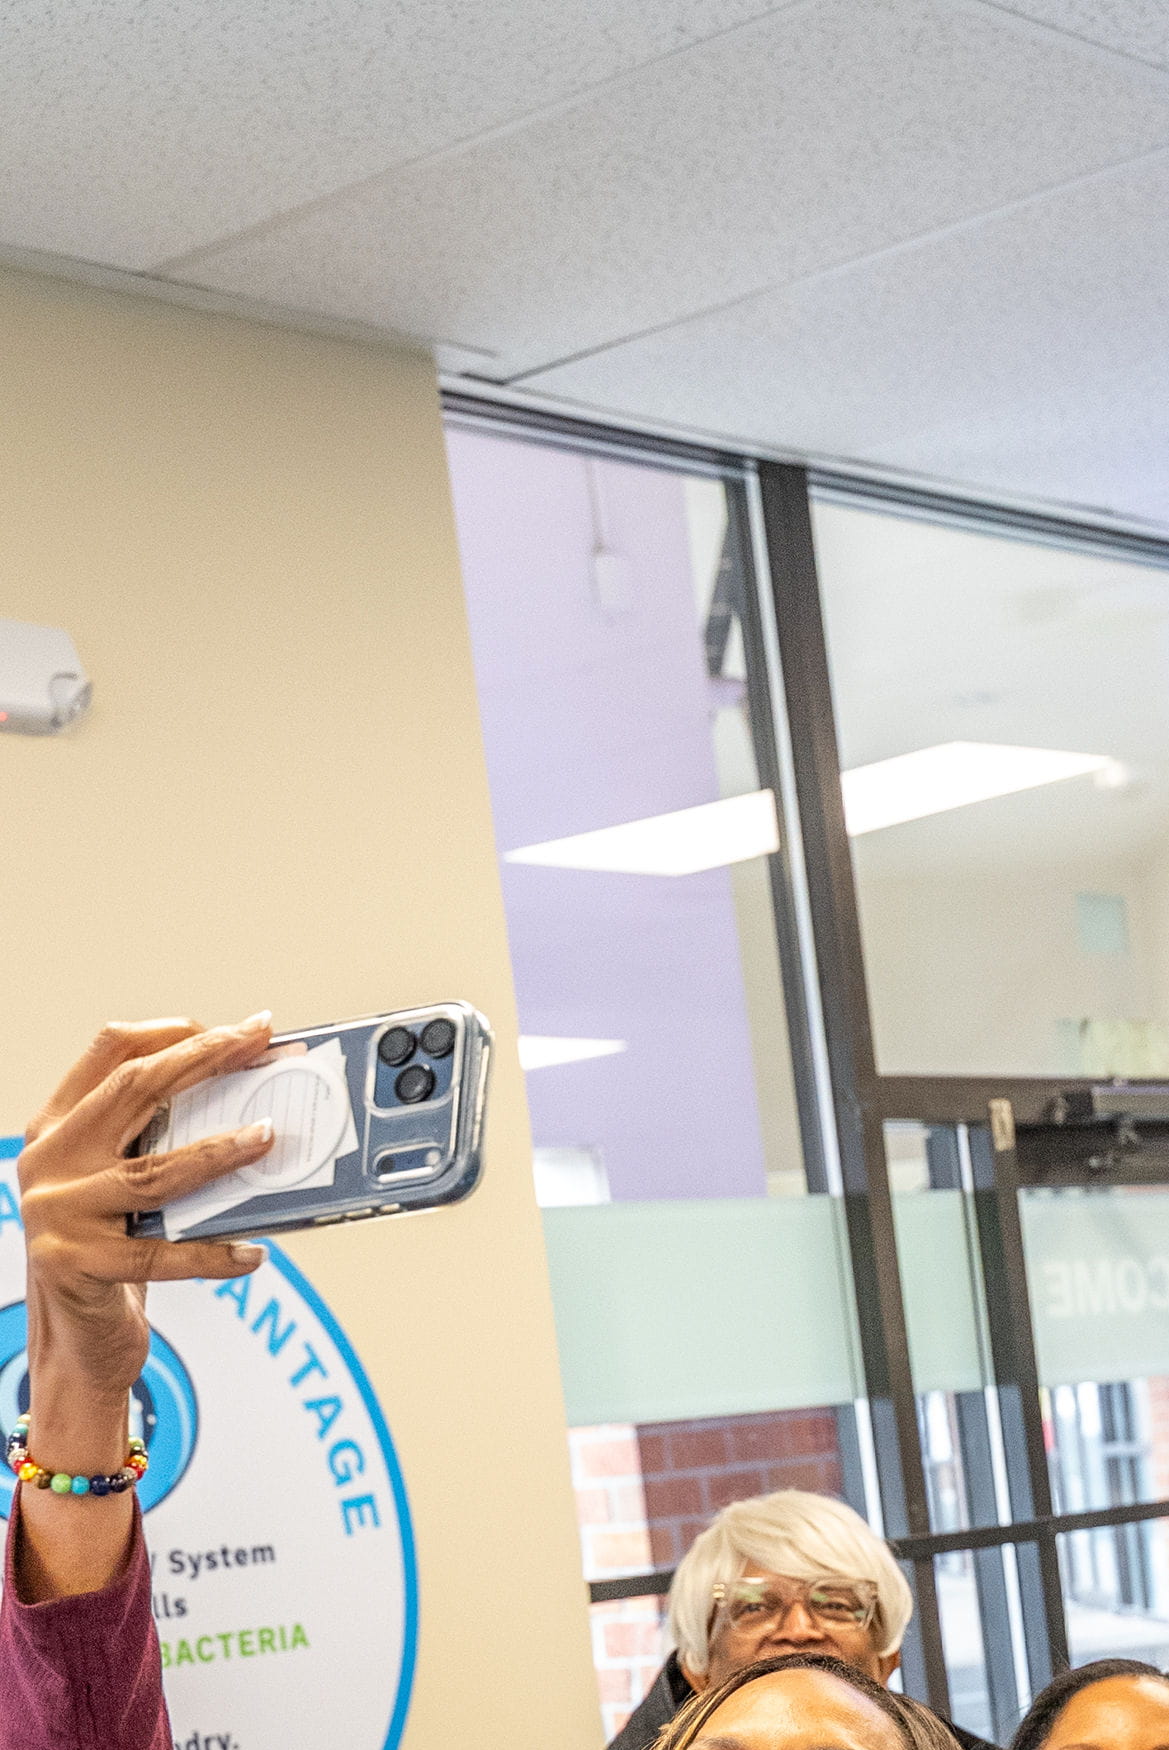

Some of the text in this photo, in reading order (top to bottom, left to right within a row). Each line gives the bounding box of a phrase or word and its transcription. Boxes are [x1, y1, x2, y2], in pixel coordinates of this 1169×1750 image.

[197, 1275, 381, 1537] ANTAGE
[169, 1545, 276, 1579] System
[161, 1623, 311, 1668] BACTERIA
